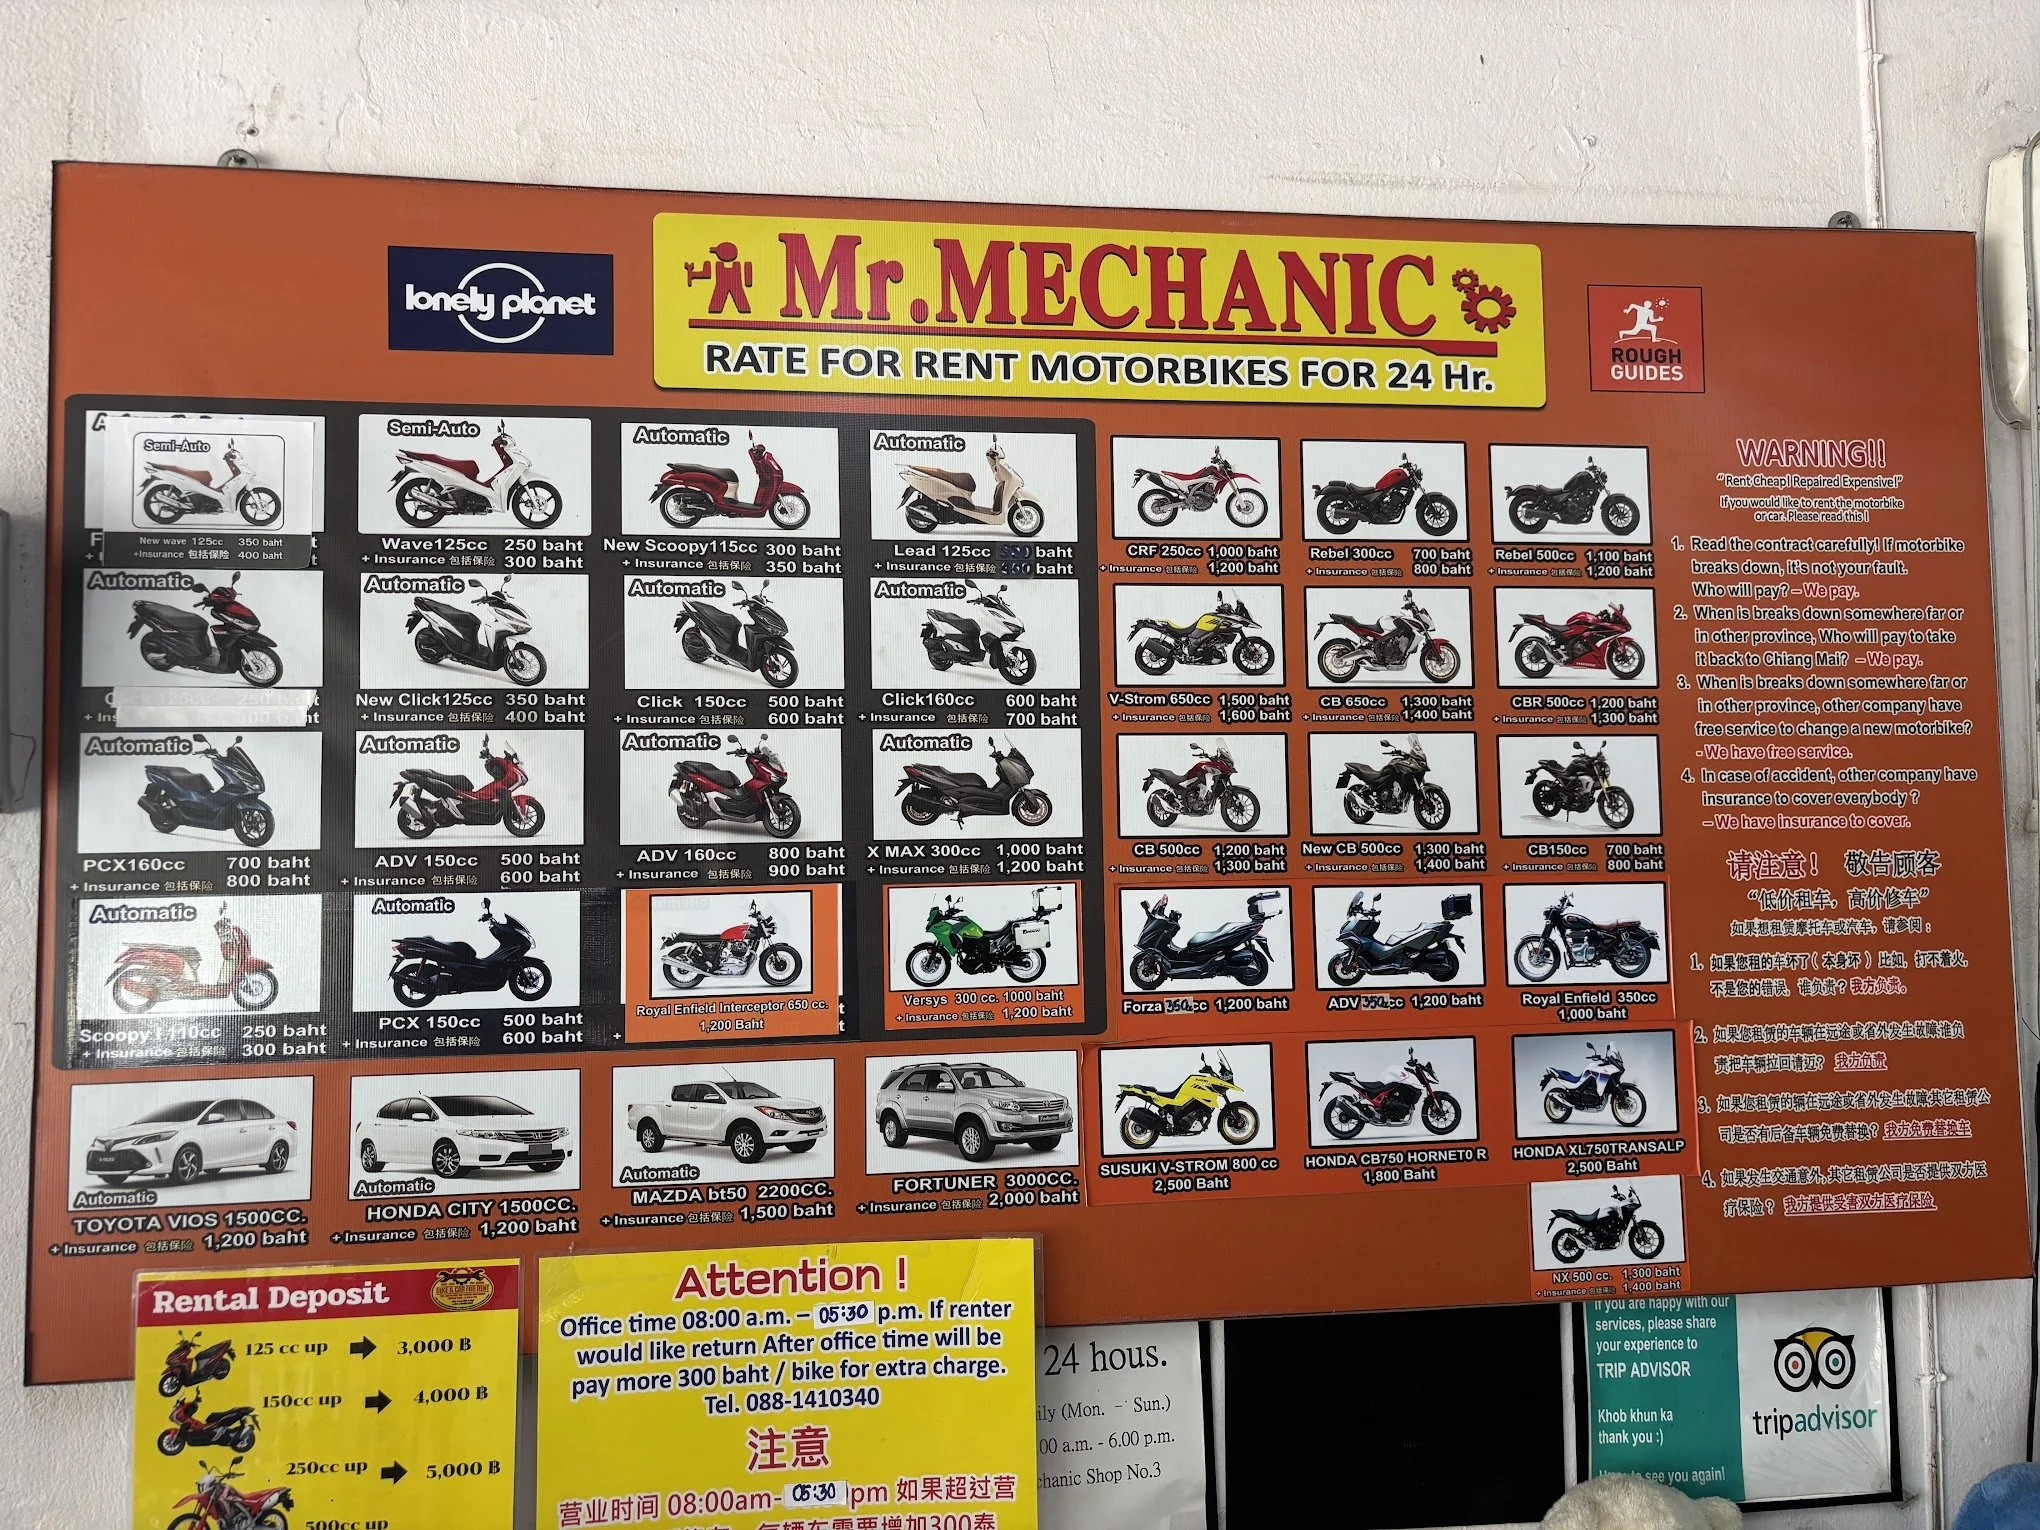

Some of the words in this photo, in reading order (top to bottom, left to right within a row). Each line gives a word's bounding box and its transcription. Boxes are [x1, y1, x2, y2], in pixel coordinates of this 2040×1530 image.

[405, 283, 495, 321] lonely
[502, 288, 596, 320] planet
[1610, 346, 1683, 365] ROUGH
[705, 343, 806, 376] RATE
[821, 347, 901, 378] FOR
[914, 349, 1019, 383] RENT
[1033, 354, 1289, 388] MOTORBIKES
[1301, 358, 1377, 390] FOR
[1384, 361, 1432, 390] 24
[1444, 363, 1494, 393] Hr.
[1610, 363, 1685, 382] GUIDES
[387, 419, 480, 437] Semi-Auto
[633, 426, 729, 444] Automatic
[144, 439, 211, 452] Semi-Auto
[1736, 439, 1886, 468] WARNING!!
[1793, 475, 1840, 489] Repaired
[139, 536, 160, 545] New
[163, 537, 186, 545] wave
[192, 537, 223, 546] 125cc
[238, 538, 260, 547] 350
[262, 538, 283, 547] baht
[382, 538, 488, 551] Wave125cc
[505, 539, 536, 551] 250
[543, 539, 583, 551] baht
[603, 539, 640, 551] New
[766, 545, 796, 556] 300
[803, 545, 841, 557] baht
[1671, 537, 1684, 551] 1.
[1691, 537, 1727, 551] Read
[1730, 538, 1751, 551] the
[1755, 538, 1813, 551] contract
[1816, 538, 1879, 555] carefully!
[1883, 538, 1894, 551] If
[1896, 538, 1964, 552] motorbike
[188, 550, 230, 560] 包括保险
[238, 551, 259, 560] 400
[262, 551, 283, 560] baht
[894, 545, 936, 557] Lead
[942, 546, 991, 557] 125cc
[1127, 545, 1157, 556] CRF
[1161, 546, 1202, 557] 250cc
[1208, 546, 1243, 559] 1,000
[1247, 546, 1278, 558] baht
[1512, 697, 1542, 708] CBR
[1546, 697, 1585, 708] 500cc
[1590, 697, 1625, 710] 1,200
[1628, 698, 1657, 710] baht
[1702, 792, 1771, 806] insurance
[1774, 793, 1789, 806] to
[1792, 795, 1832, 806] cover
[1835, 791, 1907, 807] everybody
[867, 846, 879, 858] X
[885, 846, 925, 858] MAX
[931, 845, 981, 857] 300cc
[83, 859, 186, 872] PCX160cc
[226, 856, 261, 869] 700
[267, 856, 310, 868] baht
[1844, 849, 1942, 878] 敬告顾客
[903, 995, 948, 1007] Versys
[955, 993, 977, 1004] 300
[981, 993, 999, 1003] cc.
[1003, 991, 1032, 1002] 1000
[1036, 990, 1064, 1001] baht
[1522, 993, 1561, 1006] Royal
[1565, 992, 1610, 1004] Enfield
[1617, 991, 1656, 1003] 350cc
[1514, 1146, 1566, 1159] HONDA
[1568, 1140, 1685, 1156] XL750TRANSALP
[1100, 1164, 1156, 1176] SUSUKI
[1159, 1159, 1228, 1173] V-STROM
[1232, 1158, 1257, 1170] 800
[1261, 1159, 1278, 1169] cc
[894, 1175, 996, 1194] FORTUNER
[1006, 1172, 1079, 1188] 3000CC.
[367, 1204, 441, 1220] HONDA
[447, 1201, 494, 1216] CITY
[500, 1198, 577, 1214] 1500CC.
[74, 1216, 162, 1234] TOYOTA
[168, 1213, 218, 1229] VIOS
[224, 1209, 307, 1226] 1500CC.
[674, 1258, 881, 1300] Attention
[1552, 1272, 1570, 1284] NX
[1573, 1272, 1592, 1282] 500
[1595, 1271, 1612, 1281] cc.
[153, 1287, 259, 1314] Rental
[268, 1281, 390, 1314] Deposit
[560, 1316, 622, 1337] Office
[629, 1314, 676, 1333] time
[682, 1310, 740, 1329] 08:00
[746, 1310, 791, 1326] a.m.
[819, 1304, 868, 1324] 05:30
[878, 1305, 923, 1324] p.m.
[930, 1300, 944, 1318] If
[950, 1301, 1012, 1318] renter
[1595, 1316, 1645, 1333] services,
[1648, 1317, 1683, 1331] please
[1686, 1316, 1717, 1330] share
[245, 1343, 274, 1356] 125
[279, 1343, 301, 1355] cc
[304, 1342, 329, 1357] up
[397, 1339, 454, 1356] 3,000
[577, 1342, 642, 1365] would
[650, 1341, 685, 1360] like
[692, 1339, 756, 1358] return
[762, 1334, 814, 1354] After
[820, 1331, 876, 1351] office
[883, 1330, 928, 1348] time
[935, 1327, 970, 1346] will
[977, 1327, 1001, 1345] be
[1044, 1342, 1080, 1376] 24
[1090, 1341, 1167, 1372] hous.
[572, 1377, 610, 1399] pay
[616, 1373, 672, 1392] more
[678, 1368, 716, 1387] 300
[722, 1364, 769, 1386] baht
[775, 1361, 785, 1385] /
[792, 1361, 834, 1381] bike
[840, 1360, 870, 1378] for
[876, 1359, 926, 1376] extra
[933, 1356, 1006, 1378] charge.
[1597, 1362, 1627, 1379] TRIP
[1631, 1361, 1691, 1378] ADVISOR
[262, 1394, 314, 1409] 150cc
[319, 1393, 342, 1409] up
[413, 1387, 471, 1405] 4,000
[704, 1394, 739, 1414] Tel.
[746, 1387, 880, 1412] 088-1410340
[1752, 1405, 1878, 1441] tripadvisor
[1109, 1431, 1139, 1448] 6.00
[1144, 1431, 1175, 1447] p.m.
[1598, 1429, 1629, 1445] thank
[1632, 1431, 1653, 1445] you
[746, 1424, 831, 1471] 注意
[286, 1461, 340, 1476] 250cc
[344, 1460, 368, 1476] up
[425, 1461, 483, 1479] 5,000
[1086, 1468, 1122, 1485] Shop
[1127, 1462, 1161, 1480] No.3
